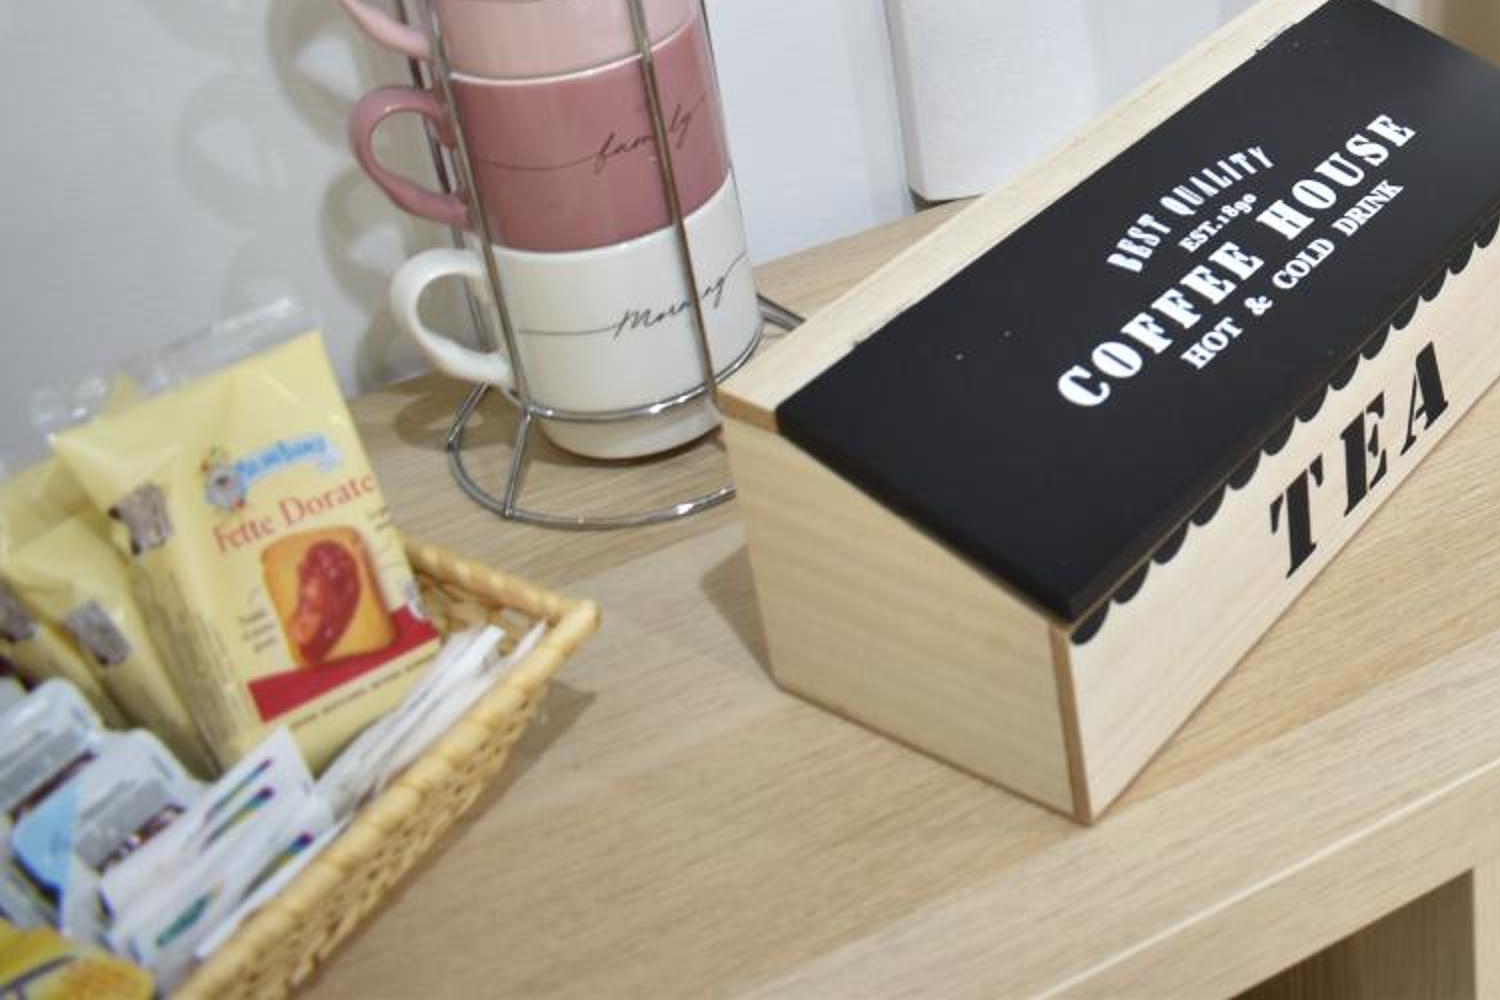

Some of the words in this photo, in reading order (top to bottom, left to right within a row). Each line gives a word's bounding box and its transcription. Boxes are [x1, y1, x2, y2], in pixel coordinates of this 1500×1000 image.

[593, 92, 706, 176] famly
[1057, 241, 1265, 407] COFFEE
[1256, 114, 1416, 240] HOUSE
[1107, 213, 1172, 273] BEST
[1160, 145, 1275, 216] QUALITY
[1178, 193, 1258, 253] EST.1890
[1180, 316, 1243, 370] HOT
[1243, 295, 1273, 316] &
[1271, 237, 1336, 290] COLD
[1331, 179, 1404, 237] DRINK
[213, 517, 277, 553] Fette
[278, 474, 376, 527] Dorate
[1269, 341, 1449, 579] TEA
